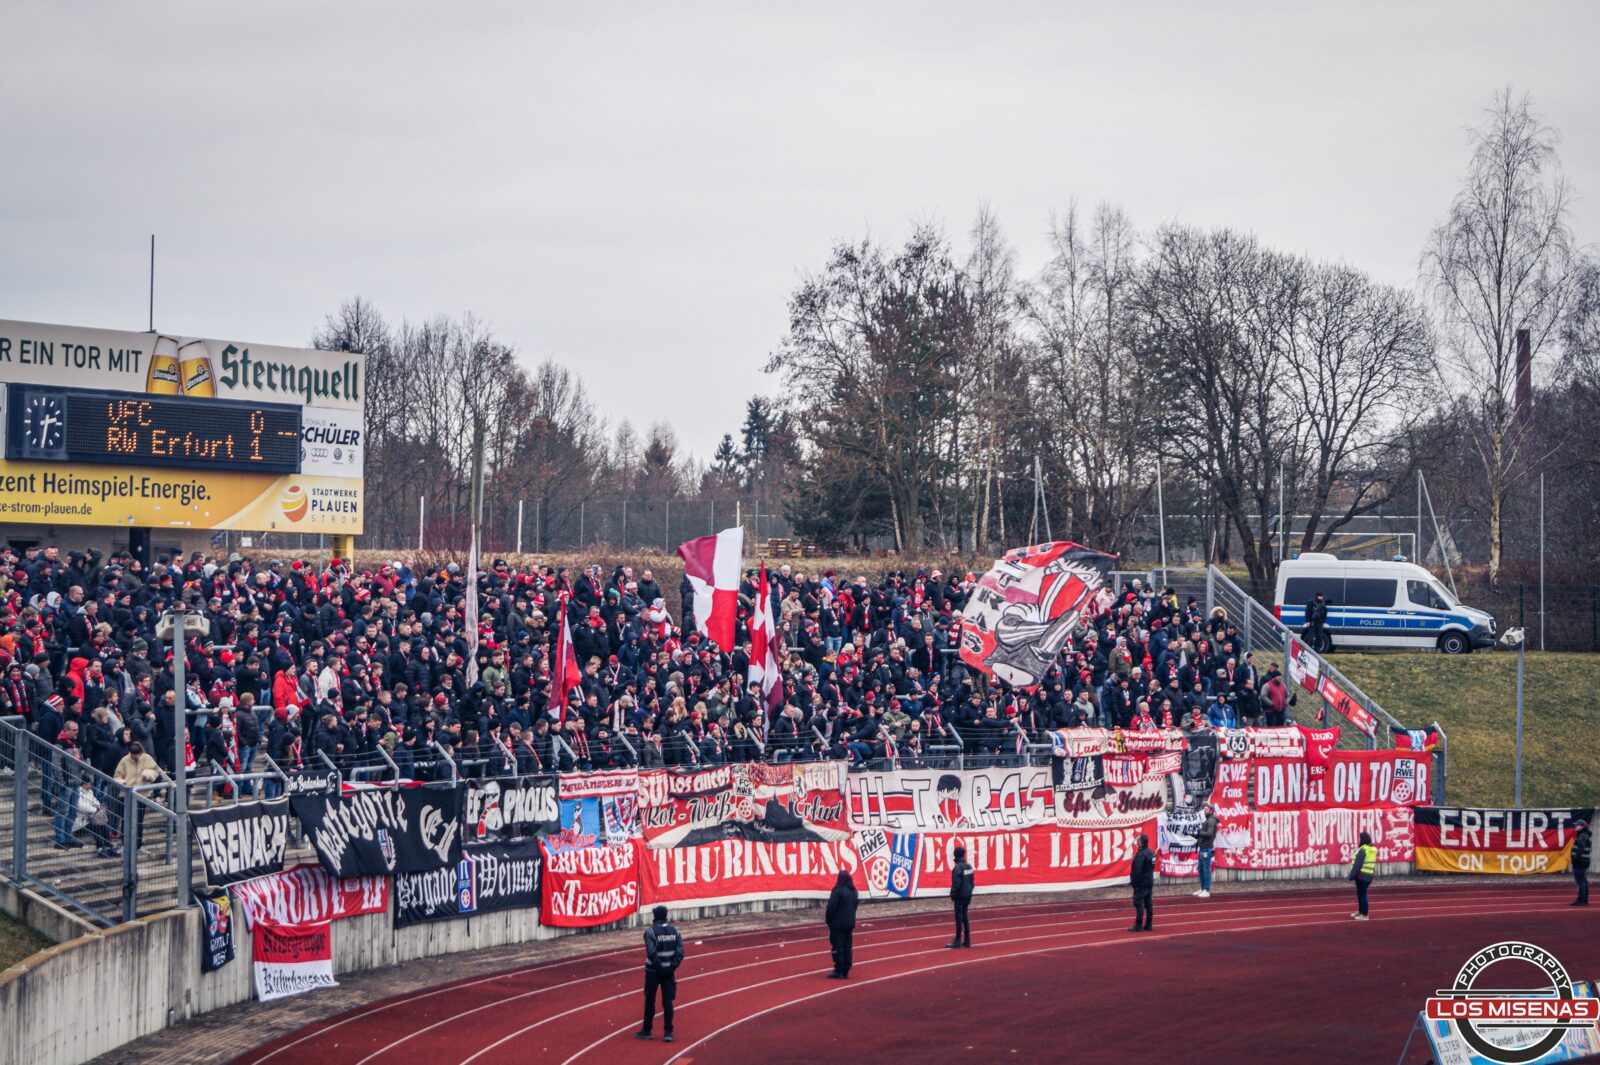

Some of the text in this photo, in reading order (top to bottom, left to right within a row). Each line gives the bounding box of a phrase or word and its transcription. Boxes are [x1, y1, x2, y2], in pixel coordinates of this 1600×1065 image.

[20, 340, 54, 366] EIN
[61, 344, 101, 369] TOR
[108, 348, 142, 373] MIT
[219, 343, 359, 406] Sternquell
[107, 427, 263, 460] RW Erfurt 1
[43, 472, 211, 506] Heimspiel-Energie.
[312, 487, 358, 498] STADTWERKE
[312, 499, 358, 513] PLAUEN
[312, 514, 358, 524] STROM
[1359, 618, 1385, 627] POLIZEI
[1230, 735, 1247, 751] 66
[1219, 763, 1248, 783] RWE
[1395, 769, 1414, 777] RWE
[1400, 760, 1411, 768] FC
[669, 775, 692, 794] LOS
[693, 766, 731, 792] CHICOS
[1222, 786, 1243, 798] Fans
[1334, 762, 1361, 803] ON
[466, 788, 485, 825] EF
[646, 804, 676, 828] Rot
[686, 791, 733, 824] Weiß
[793, 796, 842, 823] Erfurt
[1253, 808, 1383, 850] ERFURT SUPPORTERS
[1439, 810, 1572, 848] ERFURT
[196, 814, 288, 876] EISENACH
[859, 831, 885, 858] RWE
[471, 852, 541, 899] Weimar
[1458, 853, 1549, 874] ON TOUR
